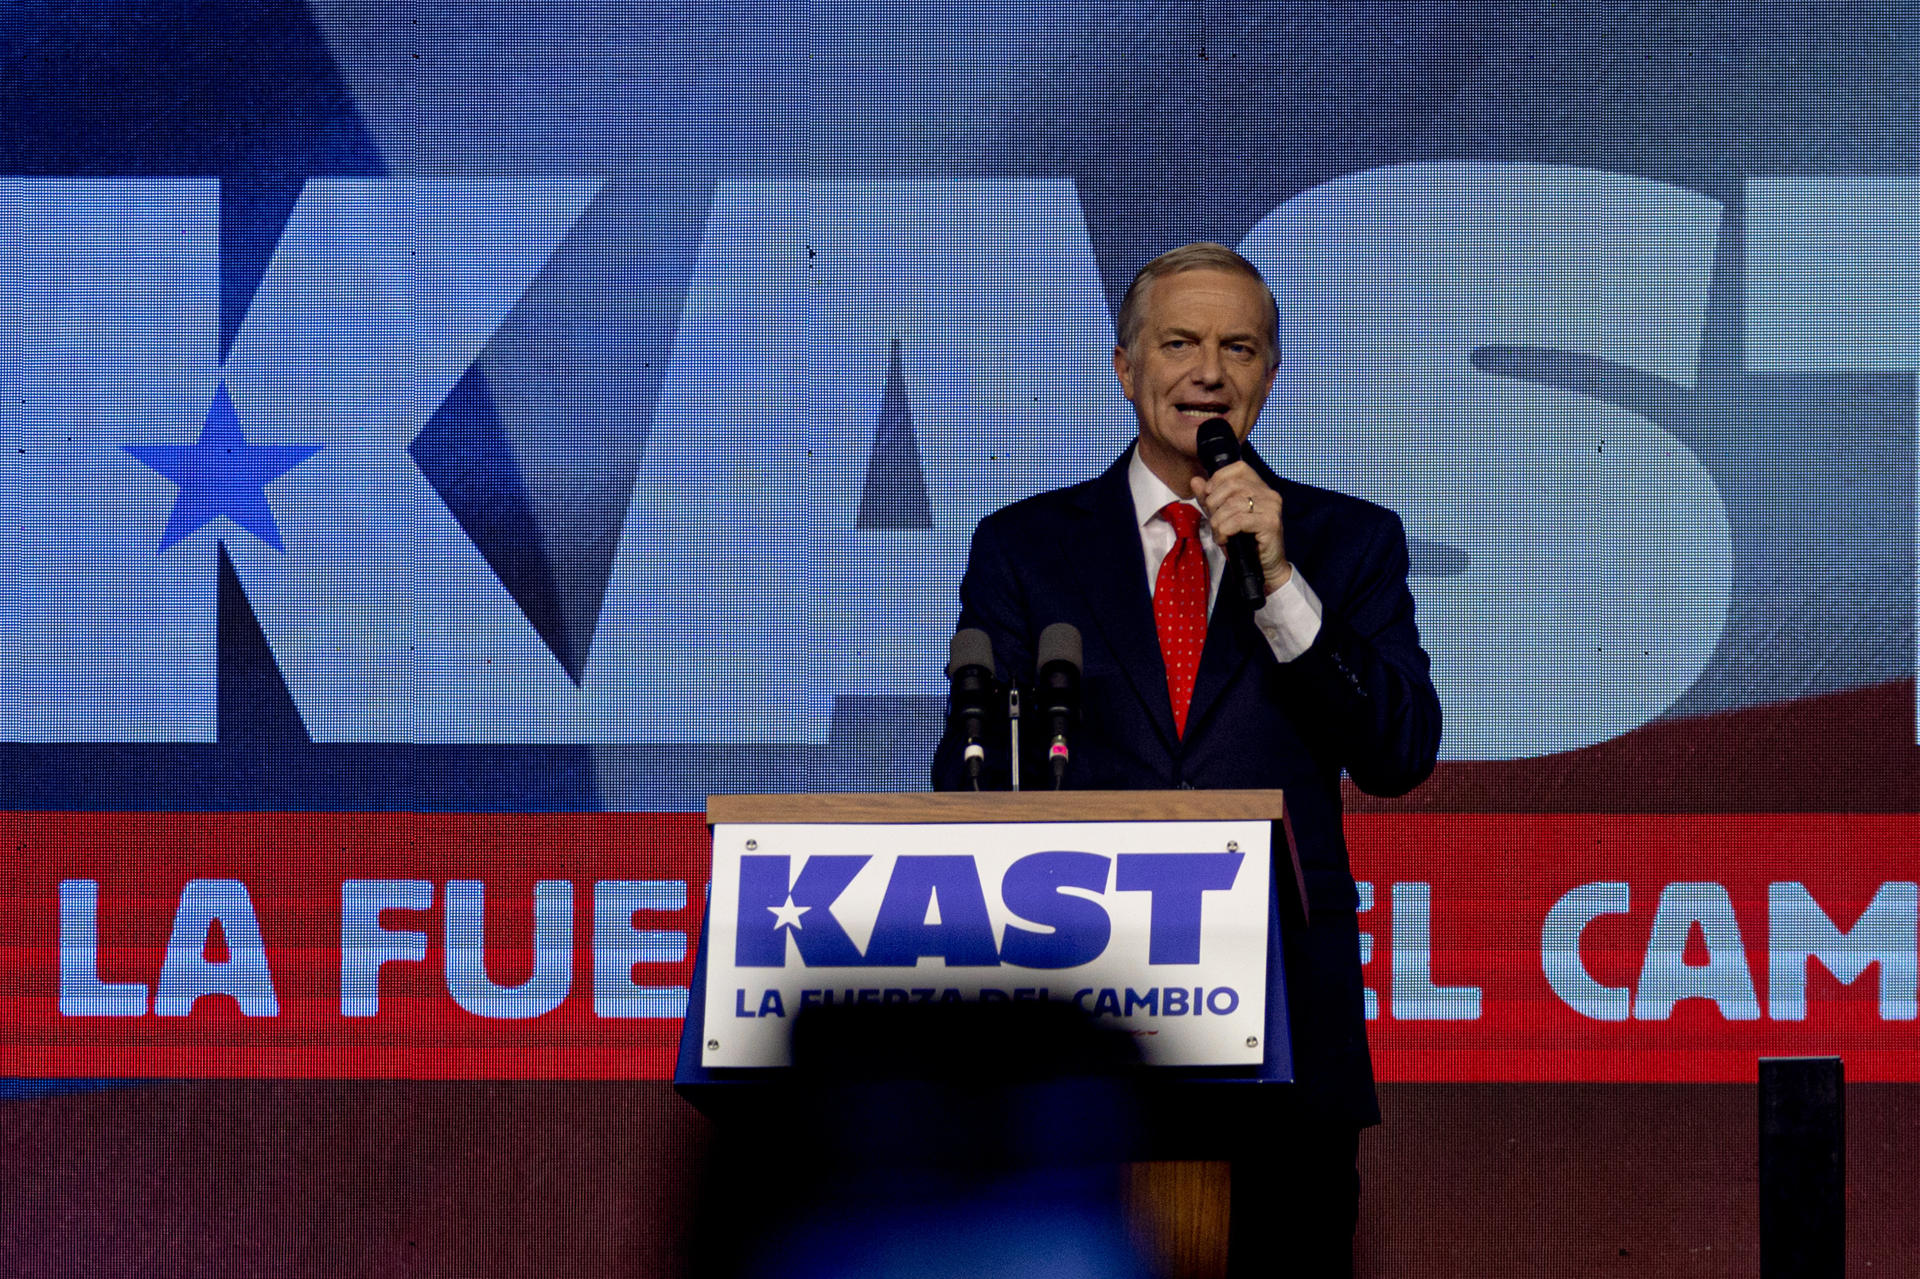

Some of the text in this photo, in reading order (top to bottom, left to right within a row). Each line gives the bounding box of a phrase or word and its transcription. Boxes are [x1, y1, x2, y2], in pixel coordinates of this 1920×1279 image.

[59, 879, 279, 1017] LA
[734, 850, 1245, 970] KAST
[1541, 881, 1919, 1021] CAM
[735, 988, 786, 1018] LA
[1072, 986, 1240, 1018] CAMBIO
